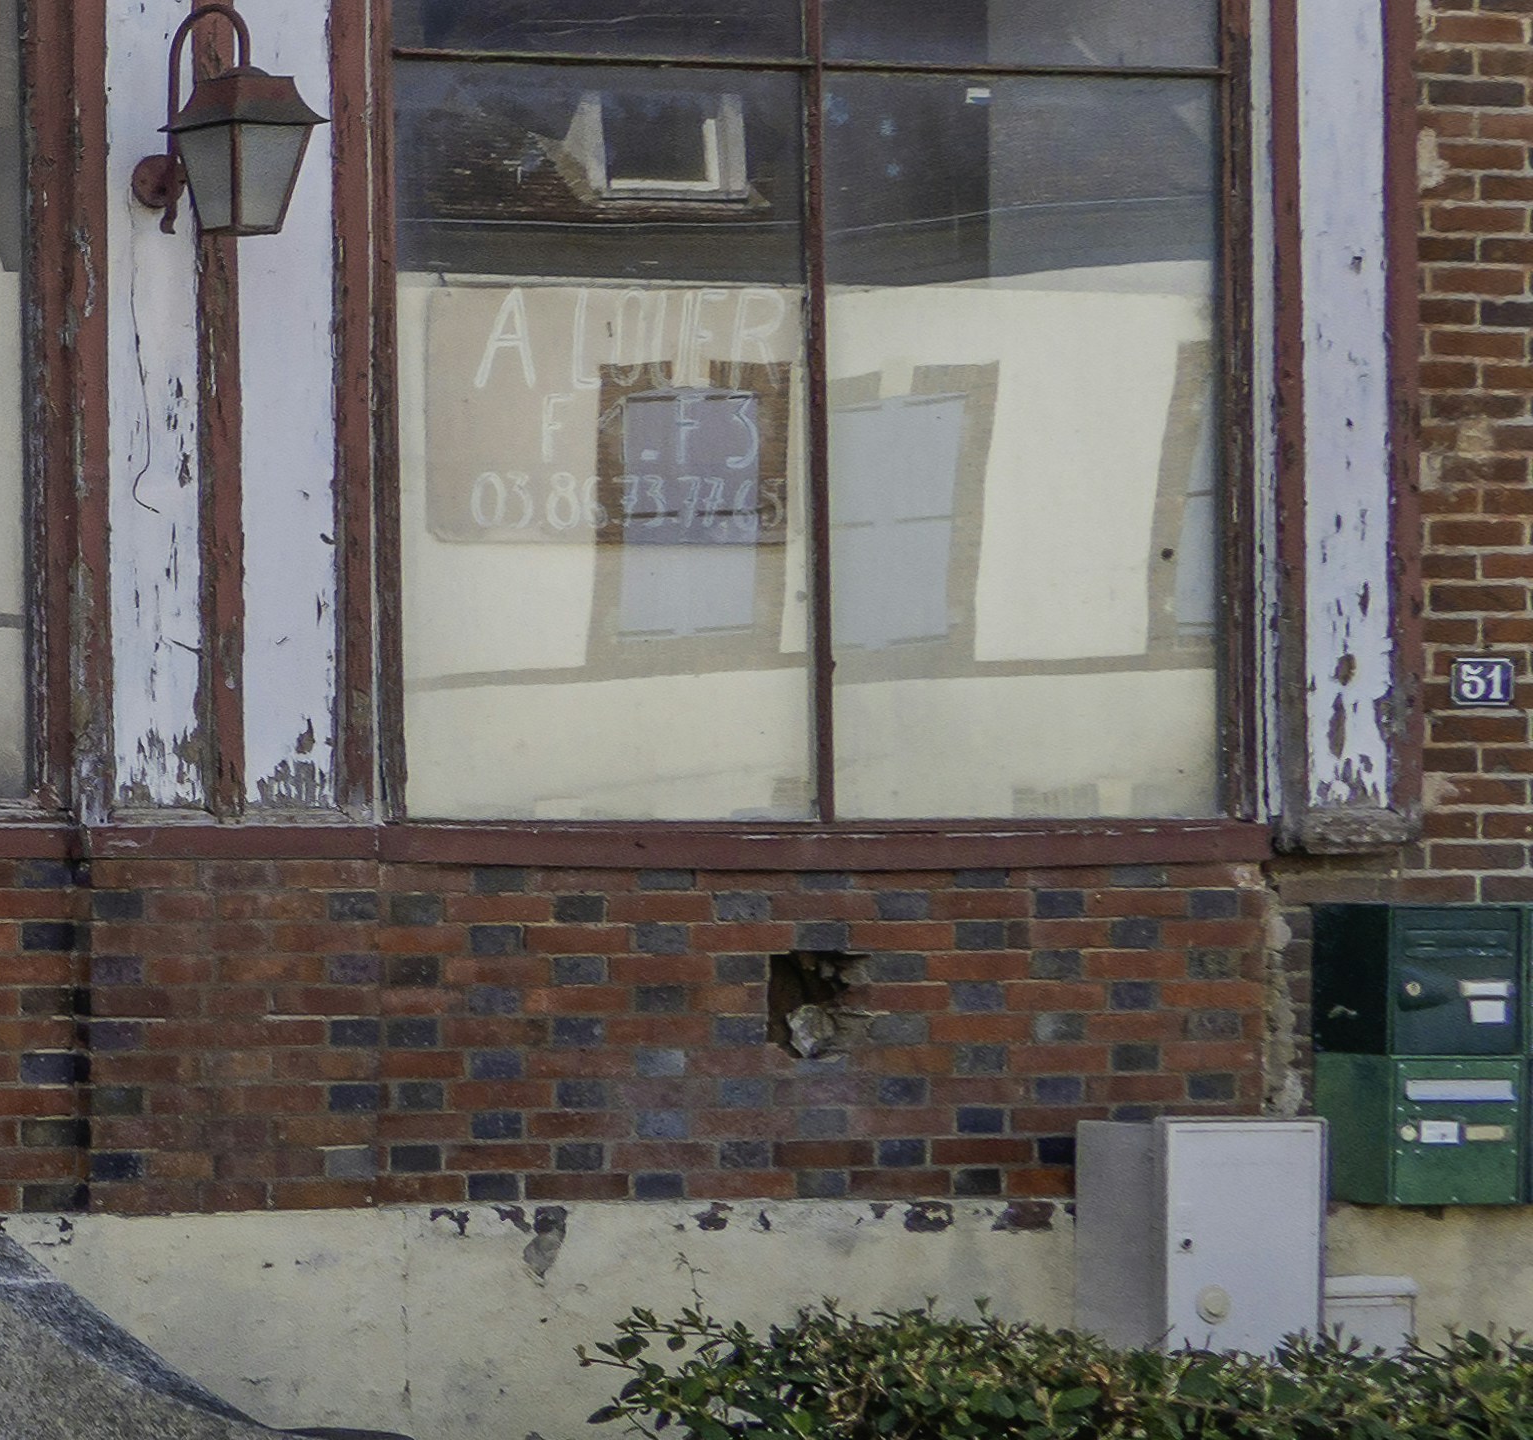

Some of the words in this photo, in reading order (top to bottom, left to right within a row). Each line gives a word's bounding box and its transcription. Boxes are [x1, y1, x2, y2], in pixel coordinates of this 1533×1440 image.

[473, 286, 537, 390] A
[571, 286, 788, 391] LOUER
[1461, 663, 1504, 699] 51
